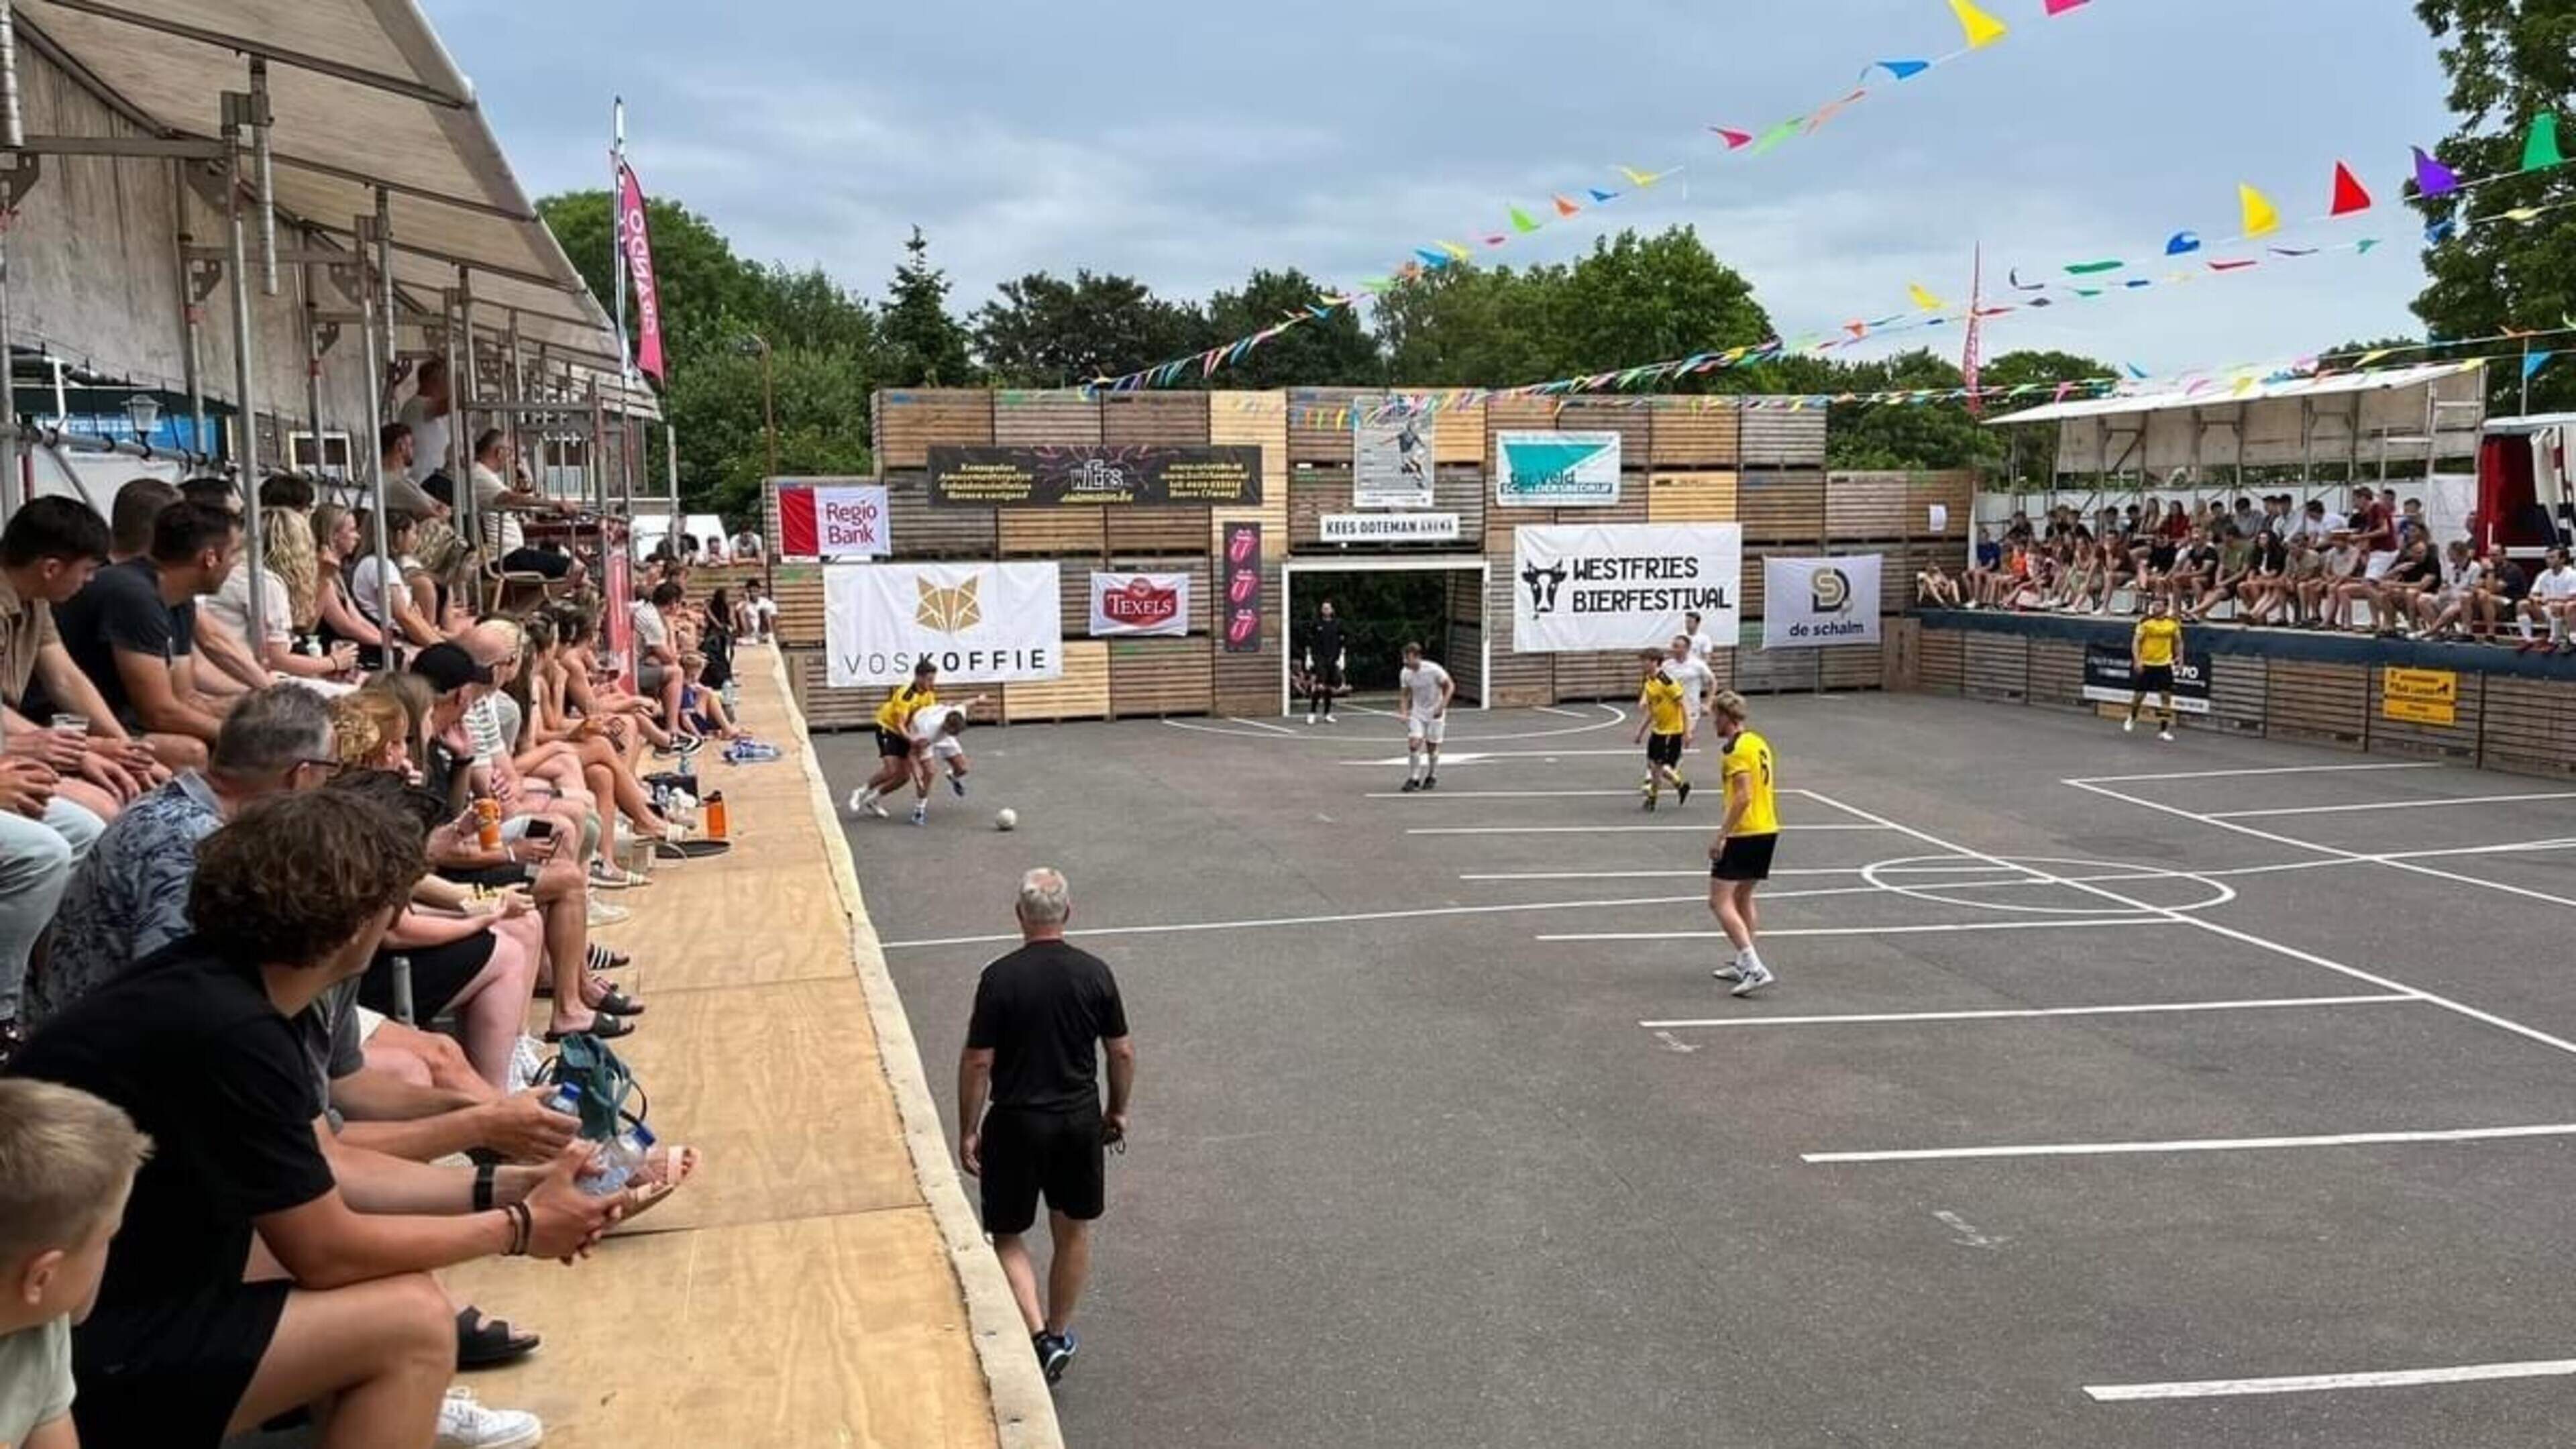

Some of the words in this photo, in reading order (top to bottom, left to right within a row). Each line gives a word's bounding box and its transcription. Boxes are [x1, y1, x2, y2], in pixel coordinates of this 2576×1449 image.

[826, 500, 877, 526] Regio
[828, 525, 875, 544] Bank
[1326, 521, 1356, 534] KEES
[1574, 557, 1699, 580] WESTFRIES
[1108, 594, 1173, 614] TEXELS
[1573, 588, 1732, 612] BIERFESTIVAL
[1789, 623, 1809, 636] de
[1813, 621, 1864, 635] schalm
